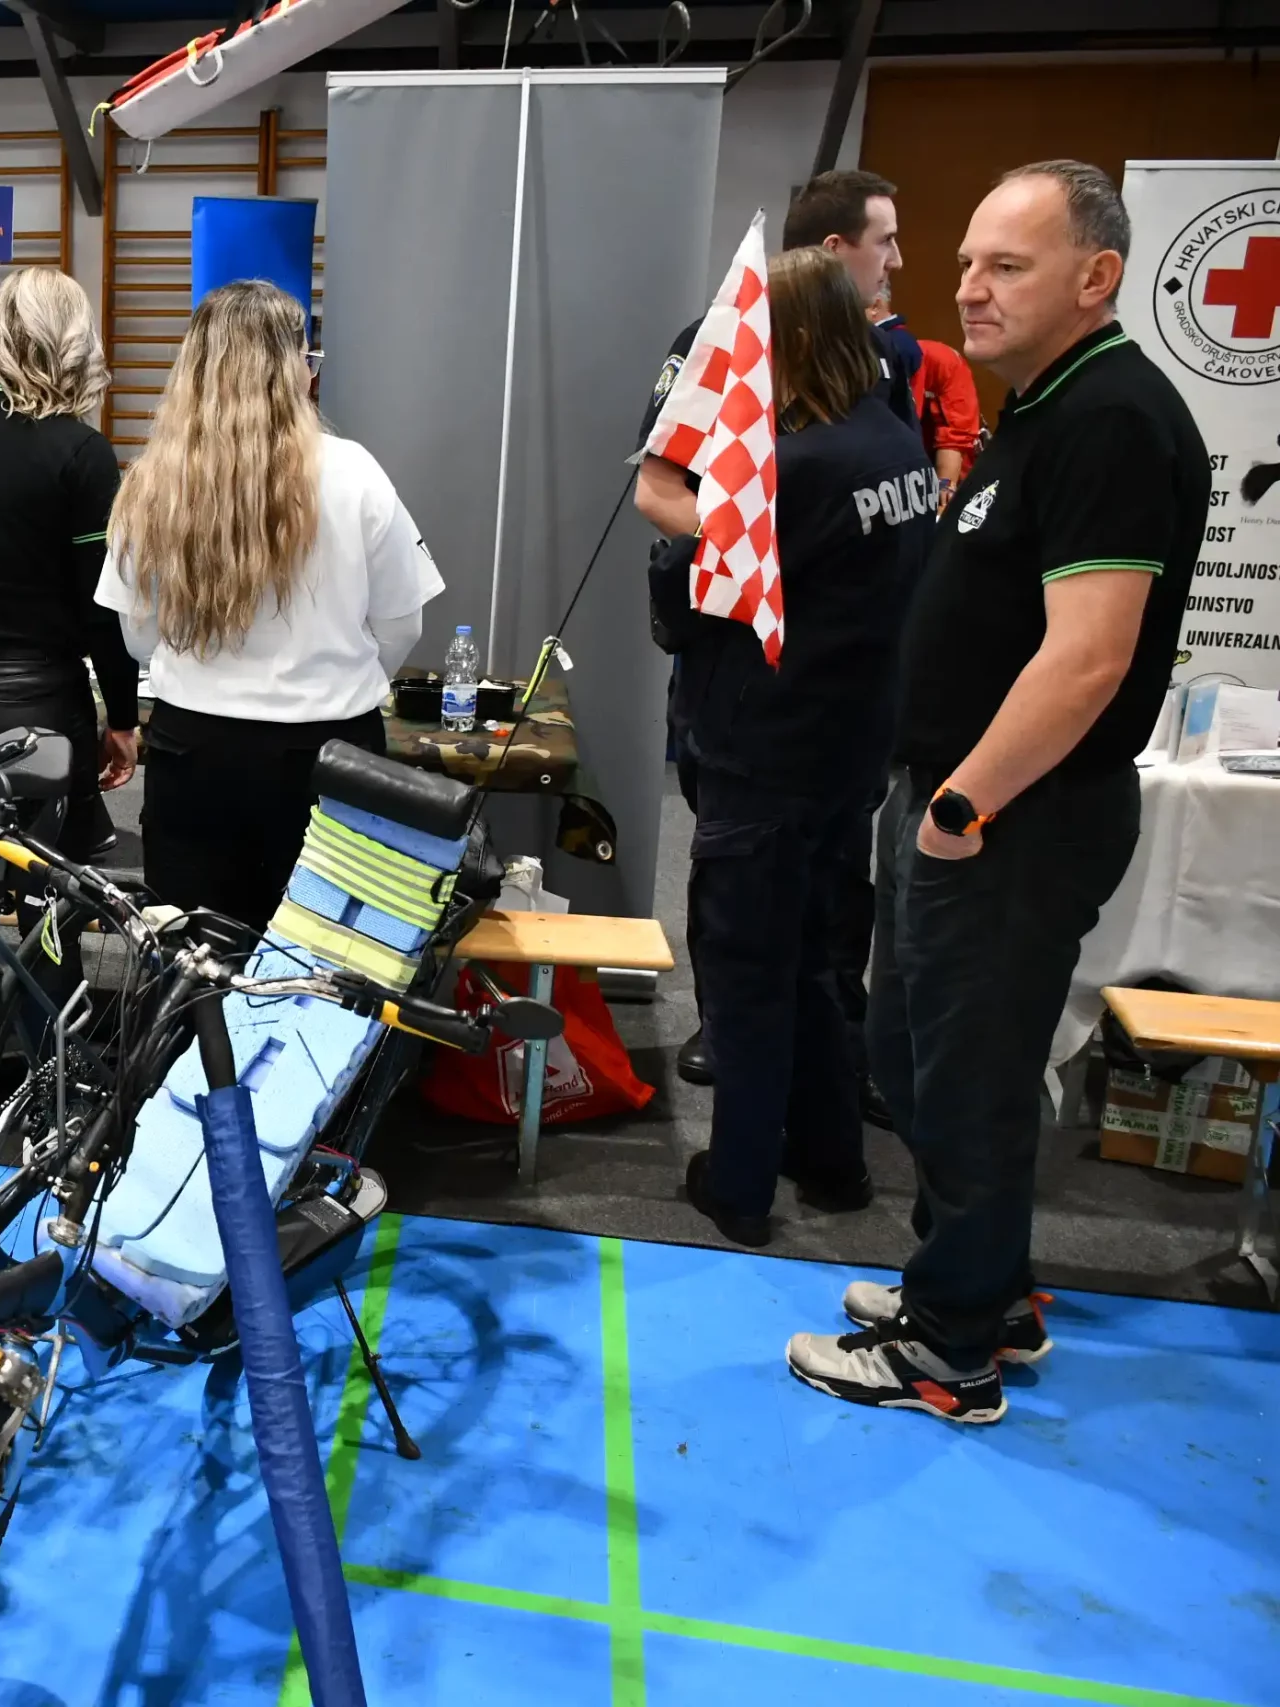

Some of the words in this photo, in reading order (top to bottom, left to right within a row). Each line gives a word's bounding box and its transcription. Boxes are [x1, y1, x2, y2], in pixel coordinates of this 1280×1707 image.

[1175, 202, 1255, 271] HRVATSKI
[1262, 199, 1280, 215] C
[1174, 300, 1203, 348] GRADSKO
[1202, 342, 1256, 366] DRUŠTVO
[1204, 358, 1280, 379] ČAKOVE
[1195, 560, 1280, 580] OVOLJNOS
[959, 1373, 998, 1389] SALOMON
